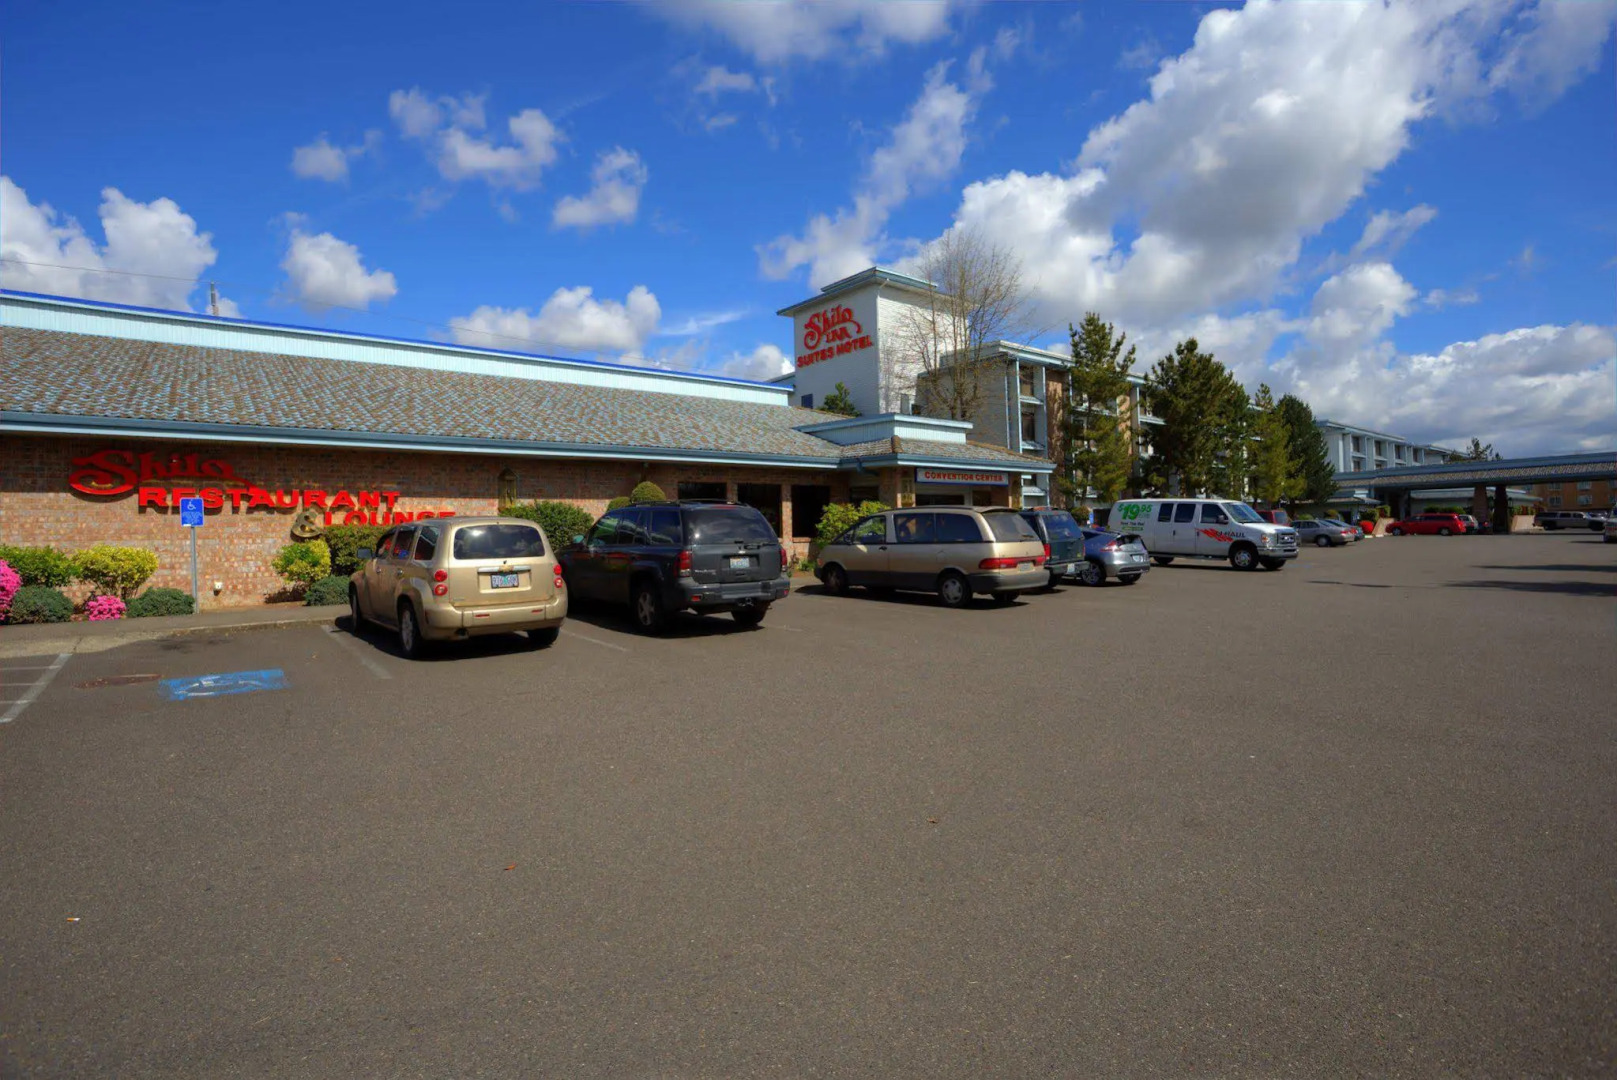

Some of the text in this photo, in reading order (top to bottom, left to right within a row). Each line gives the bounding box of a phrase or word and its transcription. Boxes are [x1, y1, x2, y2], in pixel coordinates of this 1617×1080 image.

[804, 304, 863, 350] Shilo
[797, 334, 873, 368] SUITES HOTEL
[68, 449, 260, 496] Shilo
[924, 470, 1004, 482] CONVENTION CENTER
[138, 486, 400, 508] RESTAURANT
